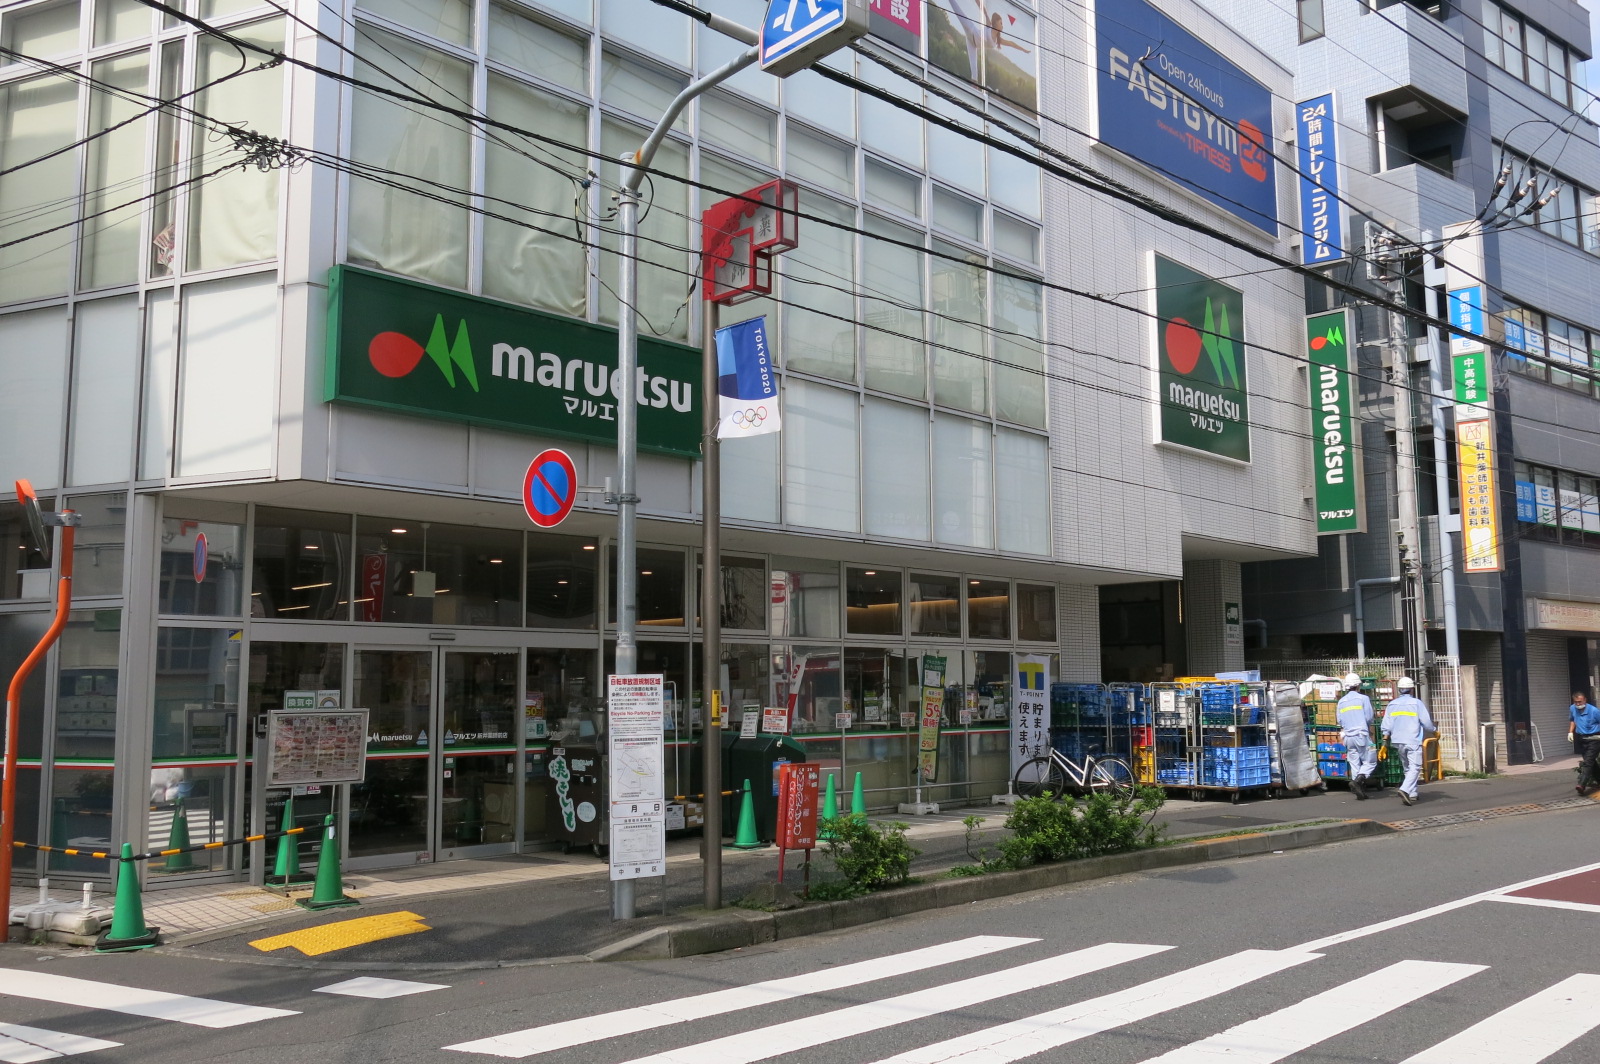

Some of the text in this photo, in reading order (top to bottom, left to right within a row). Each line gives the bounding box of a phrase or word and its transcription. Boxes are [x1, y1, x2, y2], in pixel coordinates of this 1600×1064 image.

[1159, 53, 1224, 108] Open 24hours
[1185, 132, 1232, 173] TIPNESS
[1302, 103, 1330, 259] 24時間トレーニングジム
[754, 328, 772, 394] TOKYO 2020
[1463, 357, 1477, 400] 中高受験
[562, 395, 619, 421] マルエ
[1169, 382, 1240, 422] maruetsu
[1190, 412, 1224, 434] マルエツ
[1319, 364, 1346, 485] maruetsu
[1319, 508, 1354, 520] マルエツ
[1466, 475, 1479, 526] こども歯科
[1018, 702, 1030, 756] 使えます
